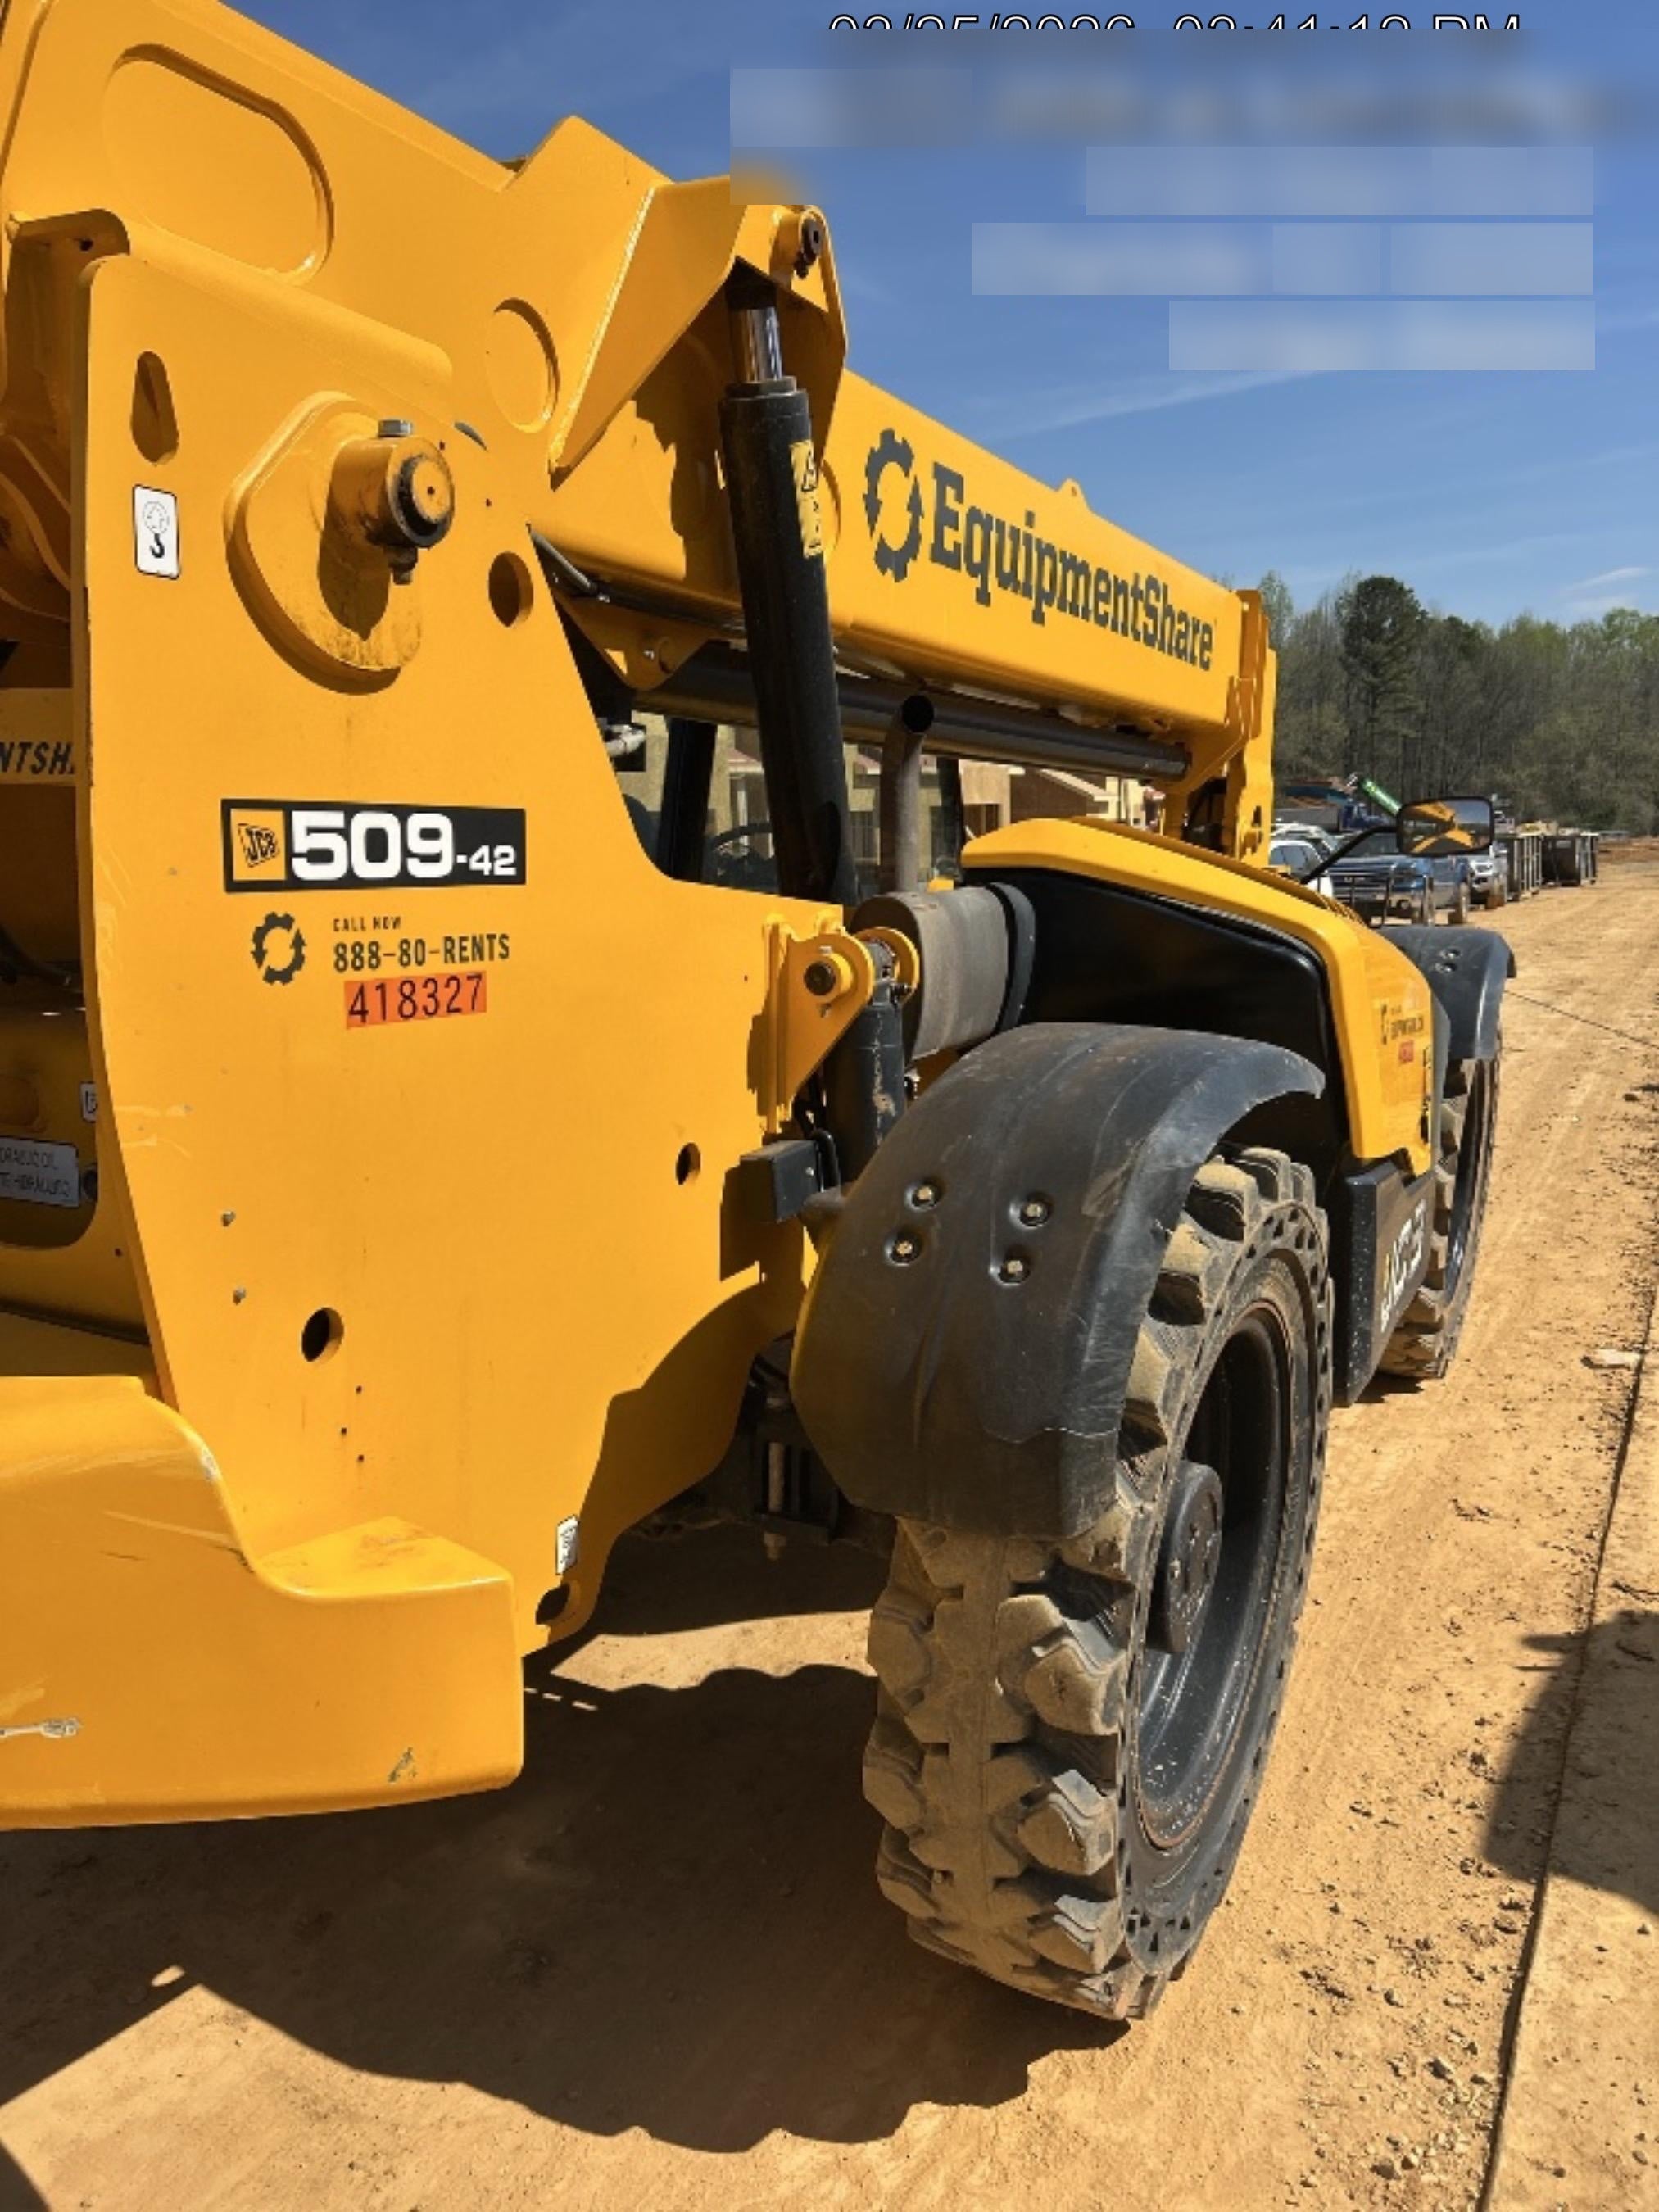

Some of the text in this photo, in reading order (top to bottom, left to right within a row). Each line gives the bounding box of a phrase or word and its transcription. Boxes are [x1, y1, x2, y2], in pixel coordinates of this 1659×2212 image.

[929, 460, 1214, 672] EquipmentShare
[0, 741, 75, 775] NTSH
[243, 809, 518, 882] JCB 509-42
[333, 915, 401, 932] CALL NOW
[333, 933, 510, 973] 888-80-RENTS
[347, 972, 483, 1024] 418327
